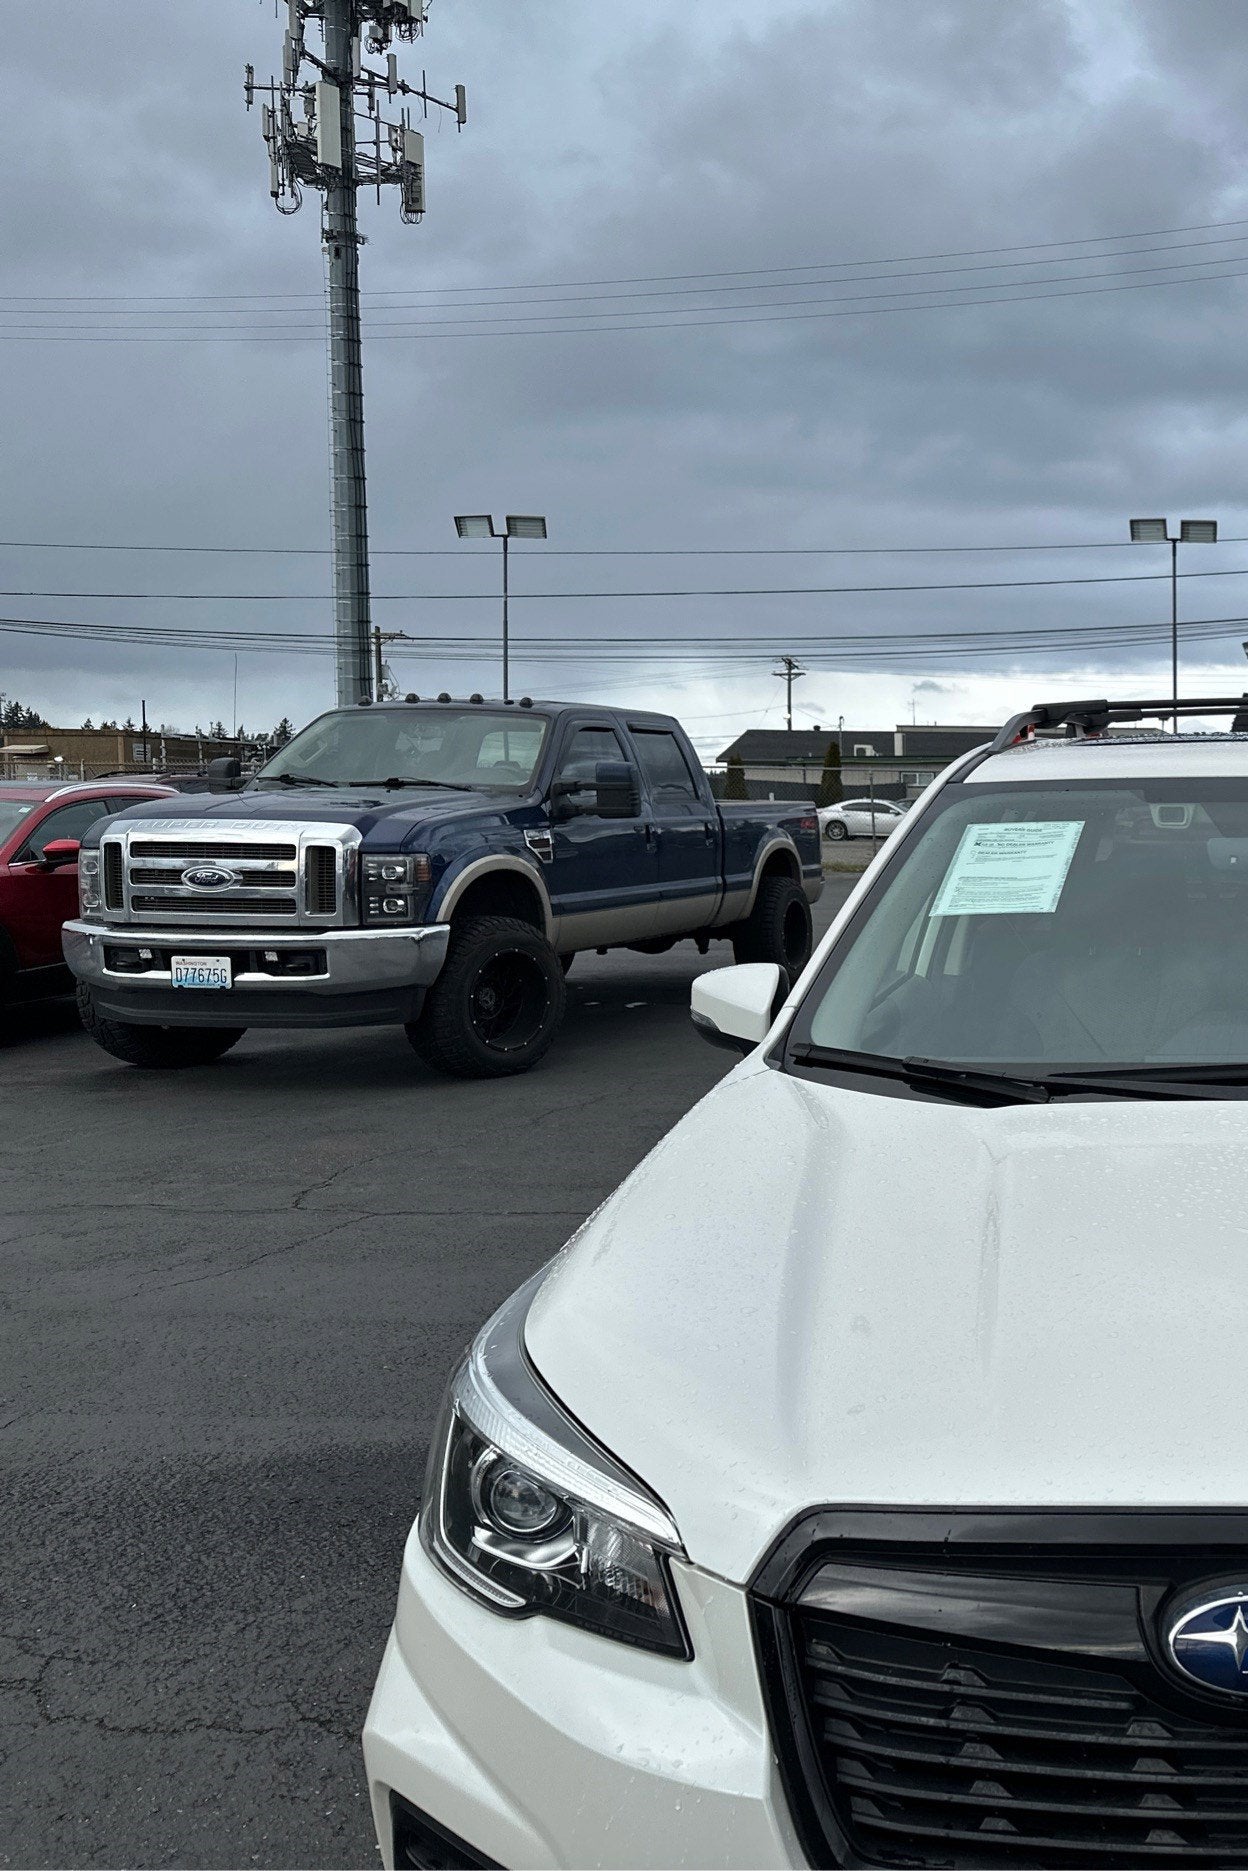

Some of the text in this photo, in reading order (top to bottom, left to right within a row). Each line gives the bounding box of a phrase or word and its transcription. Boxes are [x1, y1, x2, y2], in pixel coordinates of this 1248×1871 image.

[137, 820, 302, 831] SUPER DUTY
[195, 872, 219, 883] Ford
[175, 967, 227, 984] D77675G
